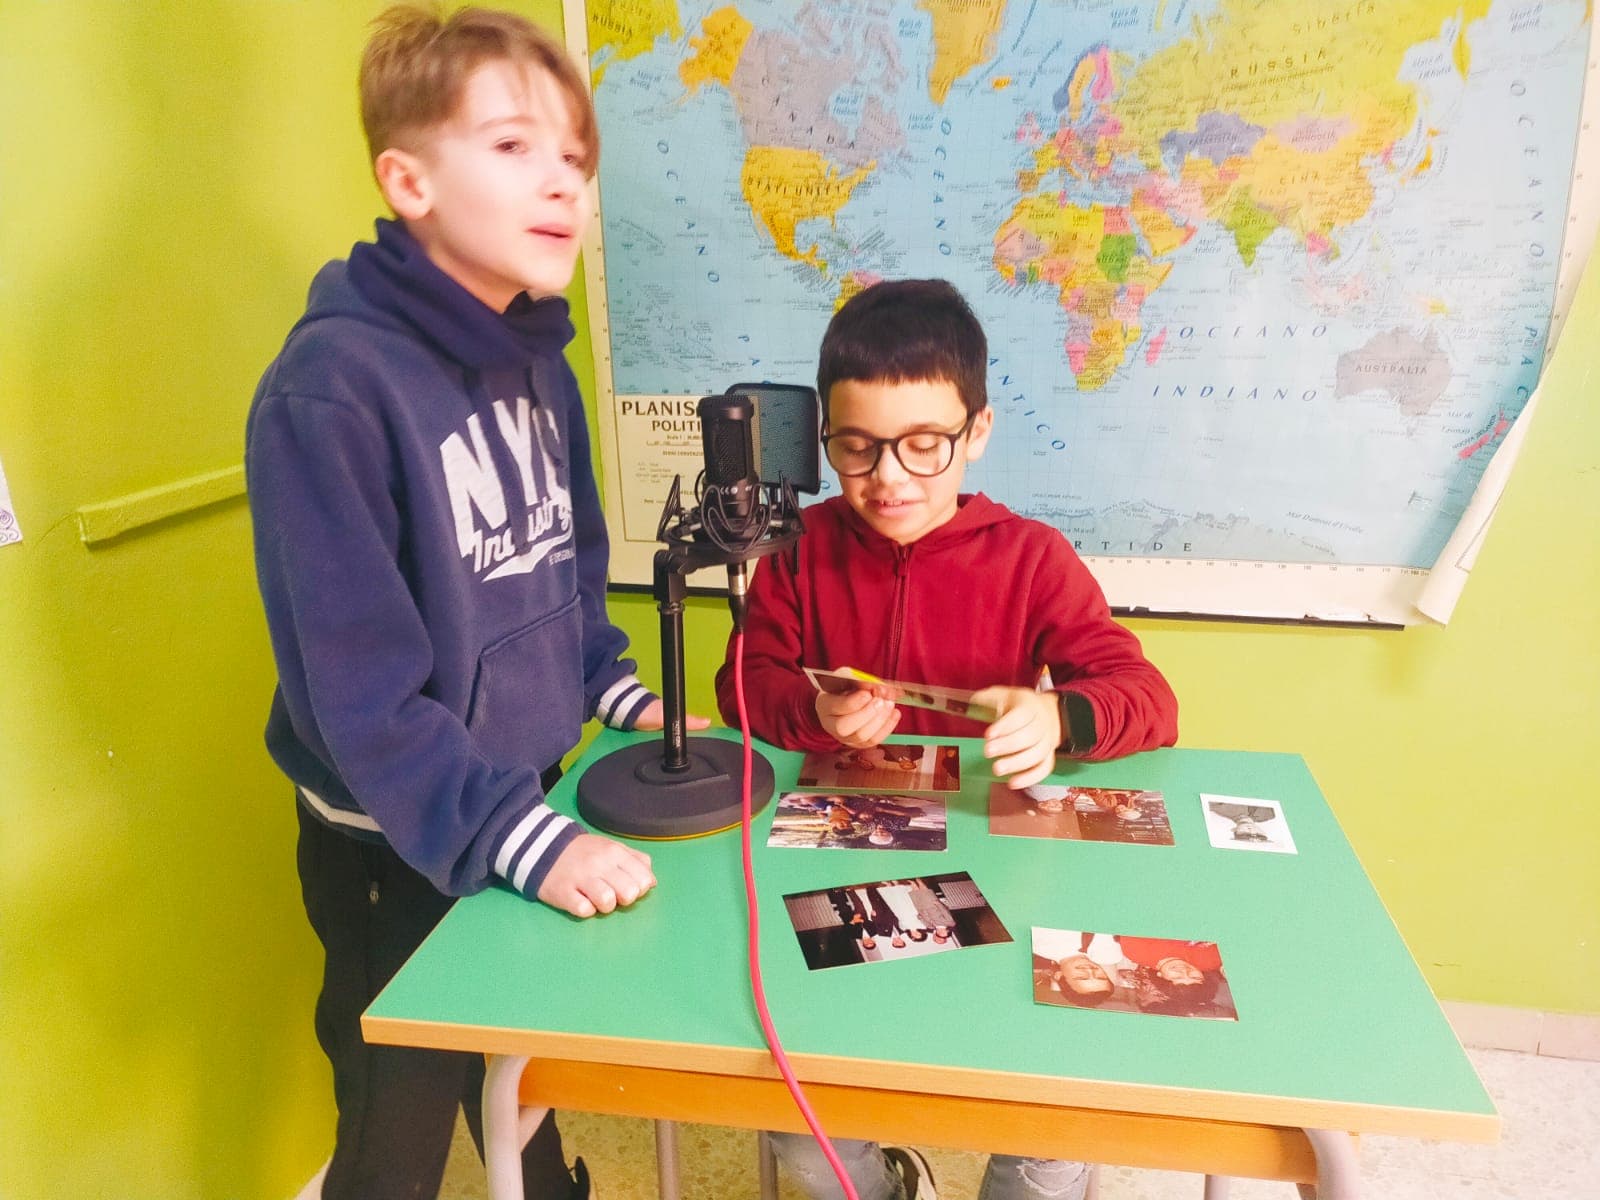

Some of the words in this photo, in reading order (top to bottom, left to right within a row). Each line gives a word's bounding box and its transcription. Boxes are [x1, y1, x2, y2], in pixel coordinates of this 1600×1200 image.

[1230, 47, 1326, 79] RUSSIA
[761, 77, 854, 149] CANADA
[1279, 171, 1319, 185] CINA
[931, 117, 952, 257] OCEANO
[655, 139, 721, 284] OCEANO
[1178, 324, 1328, 339] OCEANO
[1355, 364, 1428, 376] AUSTRALIA
[1153, 384, 1318, 402] INDIANO
[621, 400, 697, 417] PLANIS
[989, 356, 1066, 451] ANTICO
[651, 420, 703, 432] POLITI
[1073, 539, 1193, 553] RTIDE
